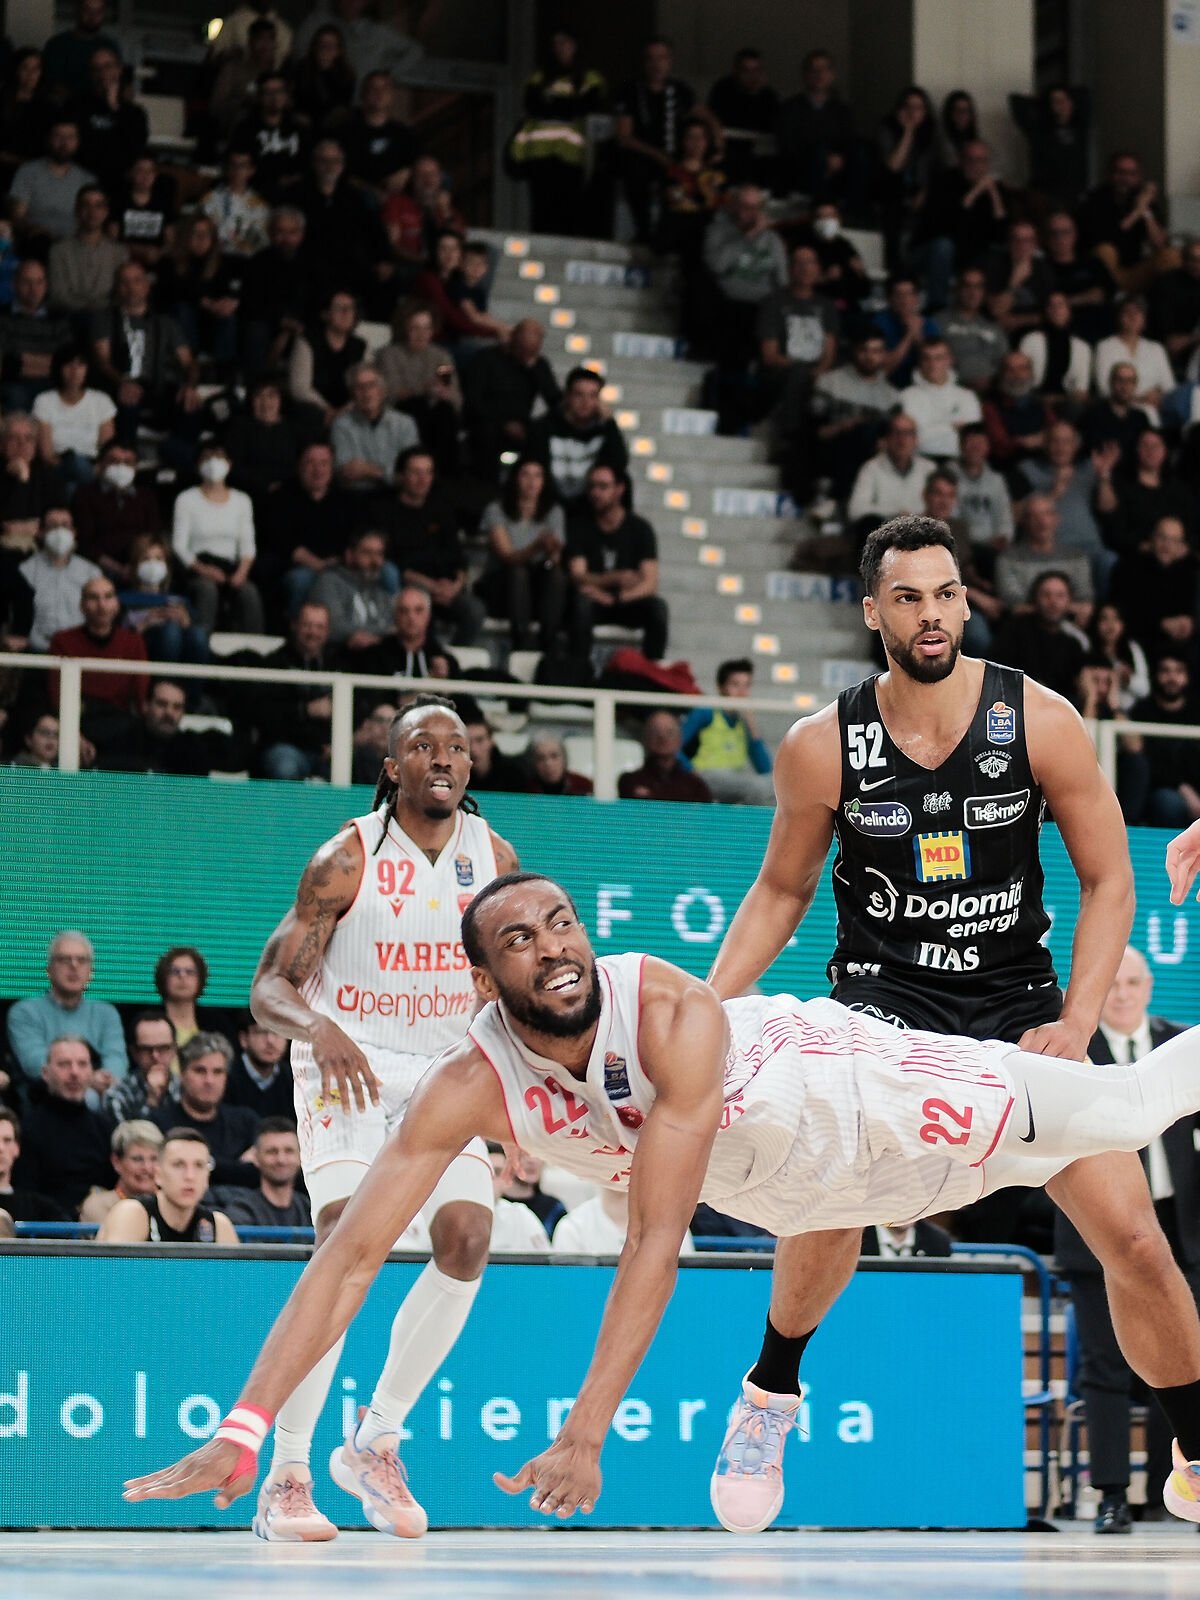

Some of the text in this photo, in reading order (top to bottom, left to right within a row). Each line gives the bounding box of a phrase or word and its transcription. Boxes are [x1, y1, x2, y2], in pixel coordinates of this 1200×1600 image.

[847, 721, 887, 770] 52
[972, 801, 1025, 822] TRENTINO
[924, 846, 961, 863] MD
[377, 859, 416, 895] 92
[375, 942, 472, 971] VARES
[916, 941, 981, 972] ITAS
[524, 1075, 590, 1135] 22
[920, 1098, 973, 1146] 22
